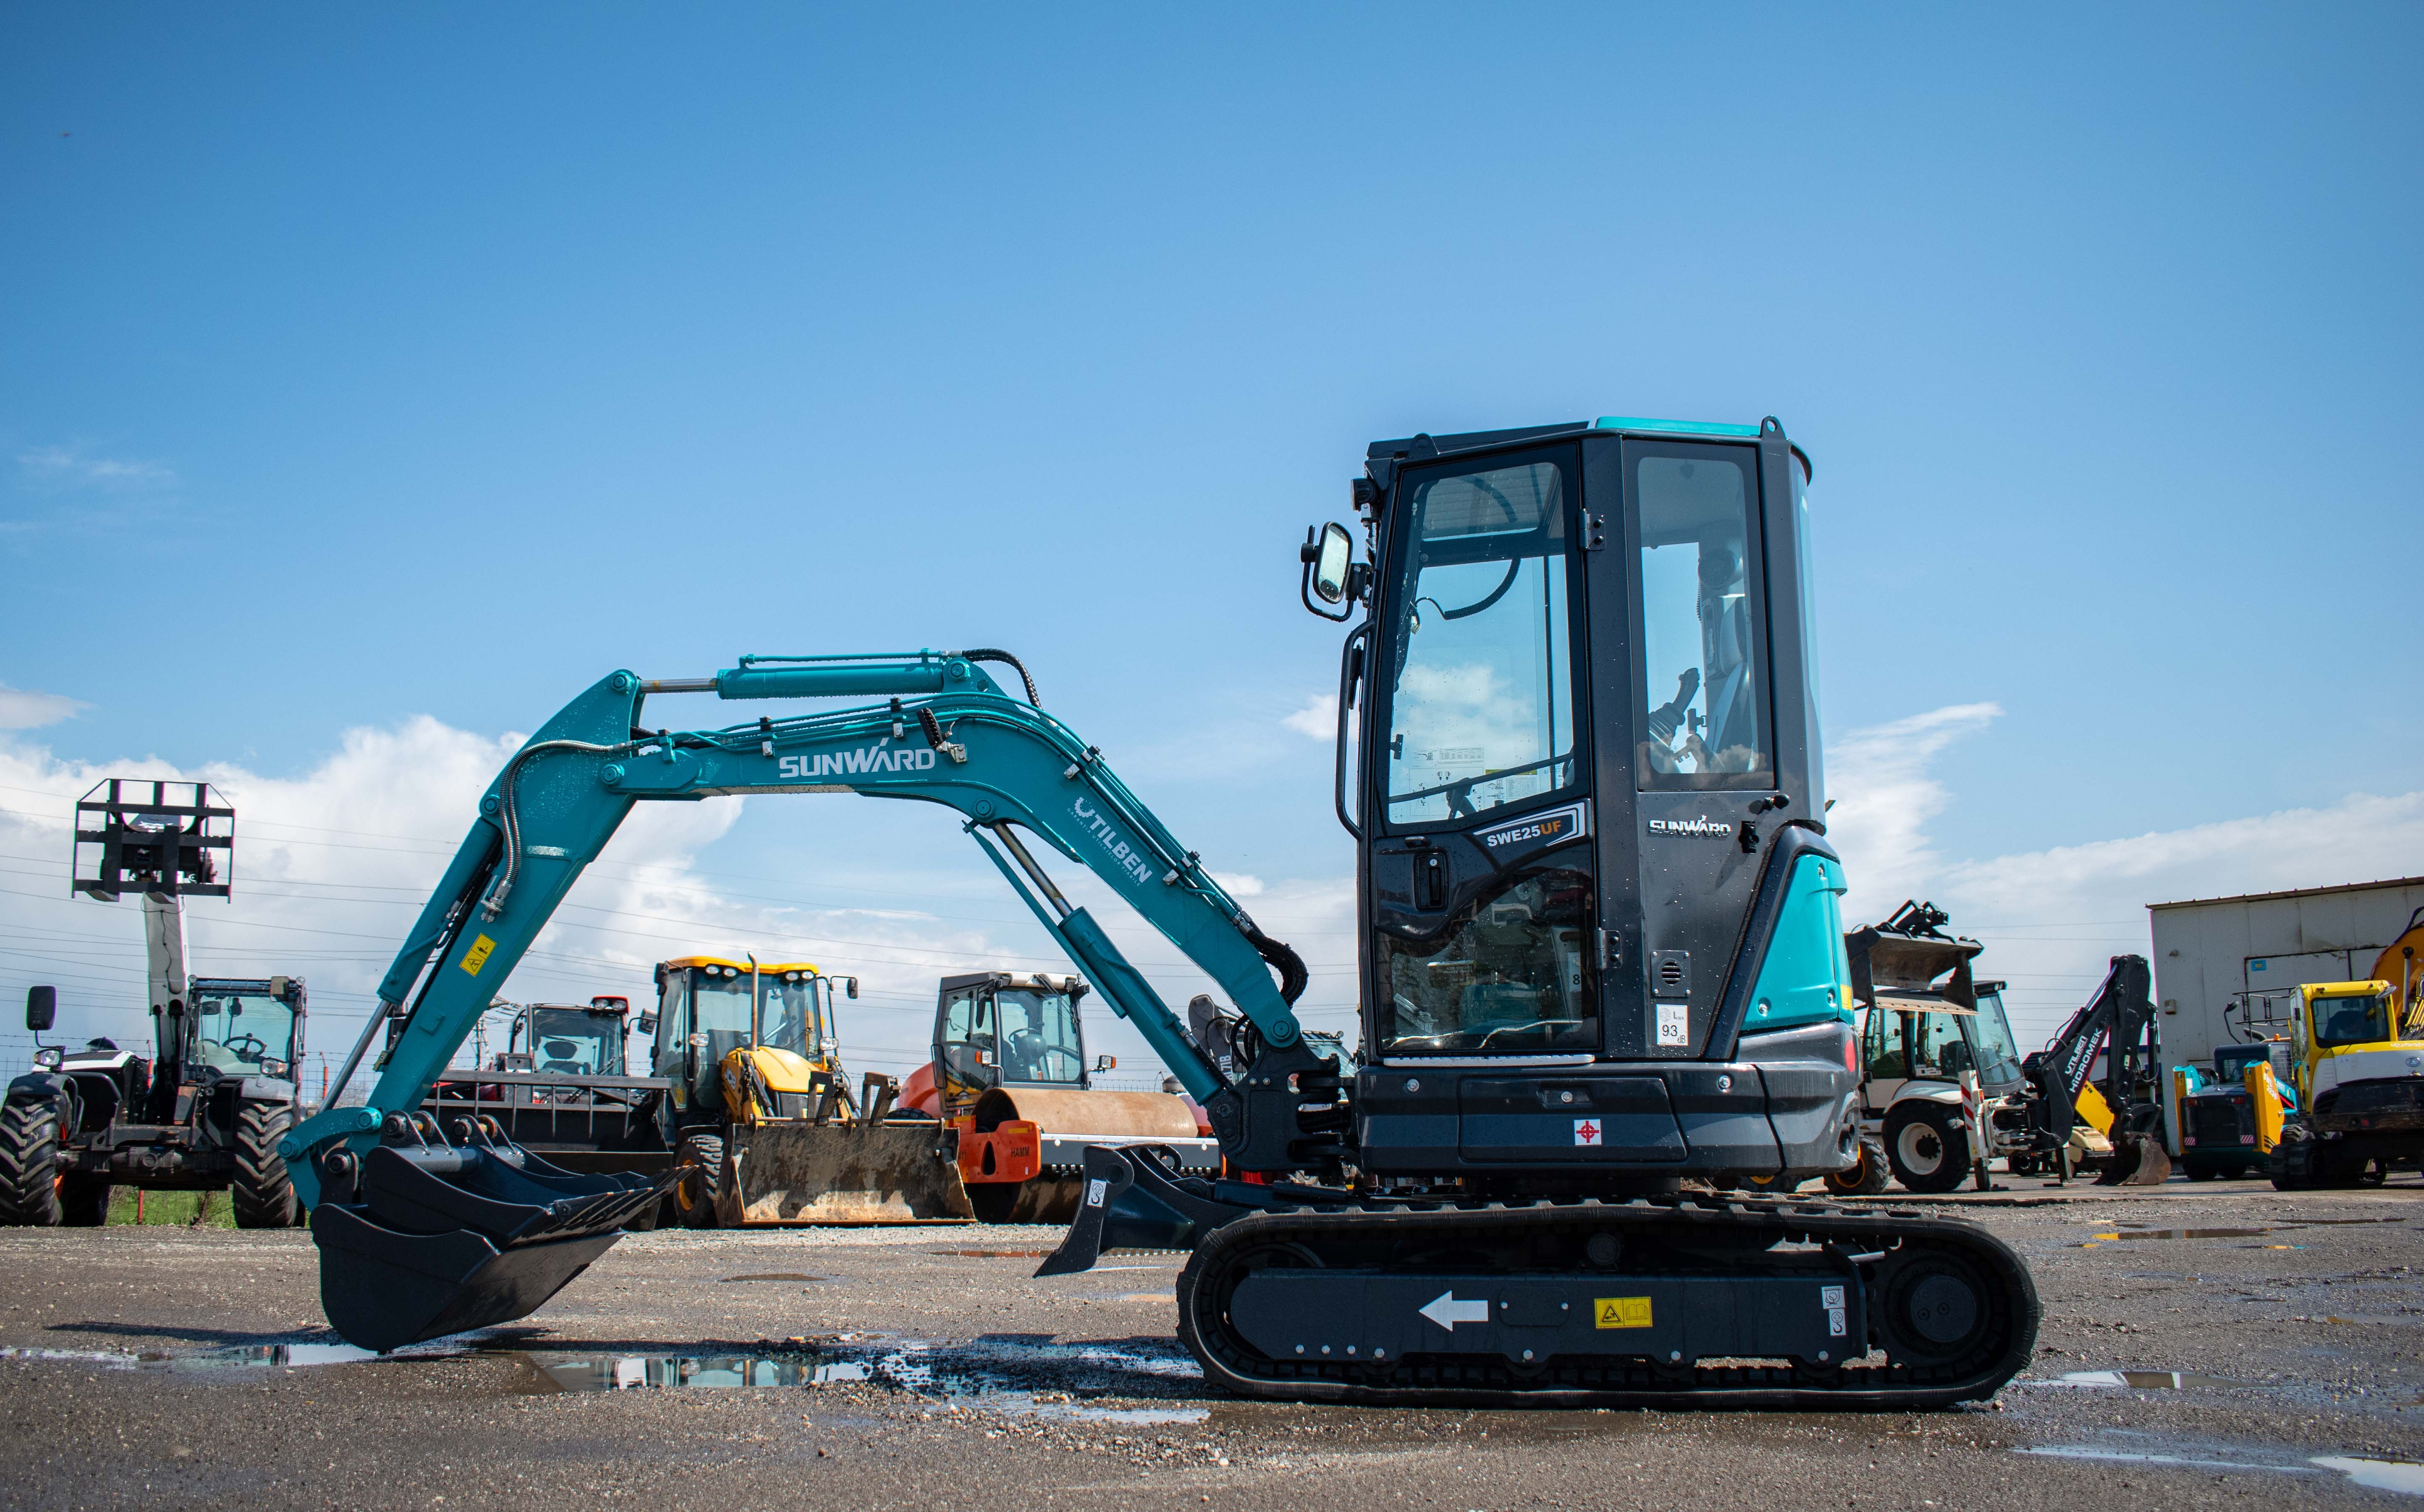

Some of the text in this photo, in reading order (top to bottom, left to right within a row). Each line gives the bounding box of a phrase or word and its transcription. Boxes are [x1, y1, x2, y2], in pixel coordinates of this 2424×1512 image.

[779, 737, 935, 778] SUNWARD
[1487, 820, 1561, 846] SWE25UF
[1649, 815, 1732, 837] SUNWARD
[1122, 866, 1140, 886] FIABILE
[1662, 1025, 1686, 1043] 93 dB
[1011, 1147, 1030, 1158] HAMM
